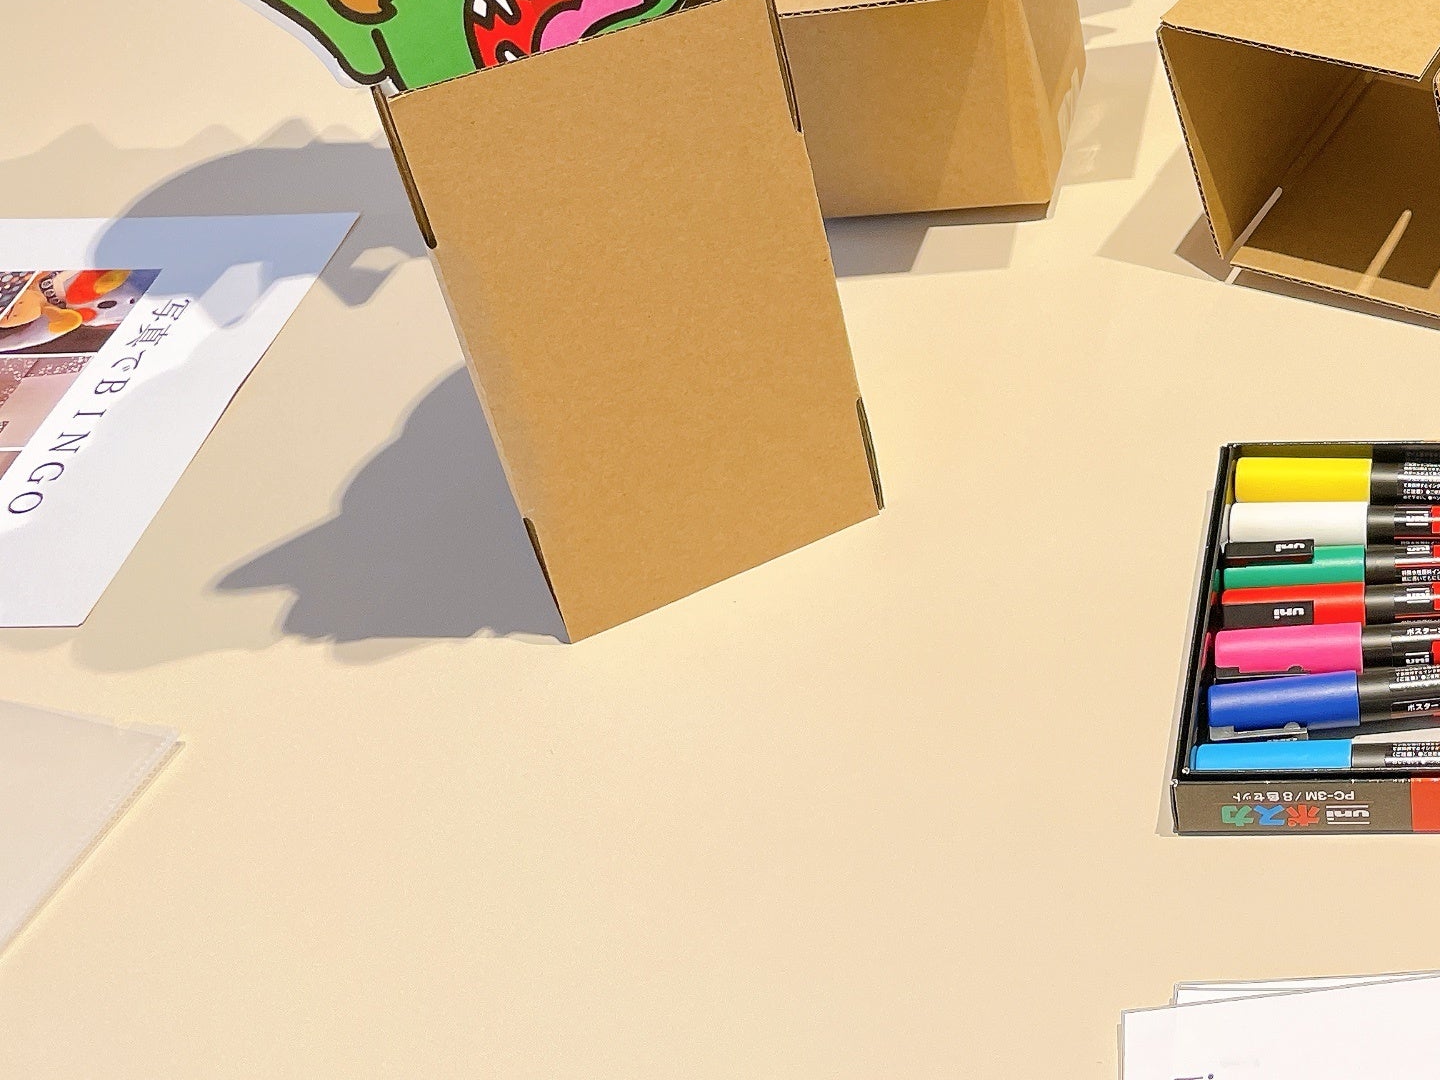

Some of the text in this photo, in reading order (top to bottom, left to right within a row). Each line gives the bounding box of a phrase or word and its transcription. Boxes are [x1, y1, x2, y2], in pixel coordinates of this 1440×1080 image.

[1275, 543, 1306, 552] uni
[1273, 607, 1305, 619] uni
[1220, 805, 1320, 826] ポスカ
[1326, 808, 1371, 822] uni
